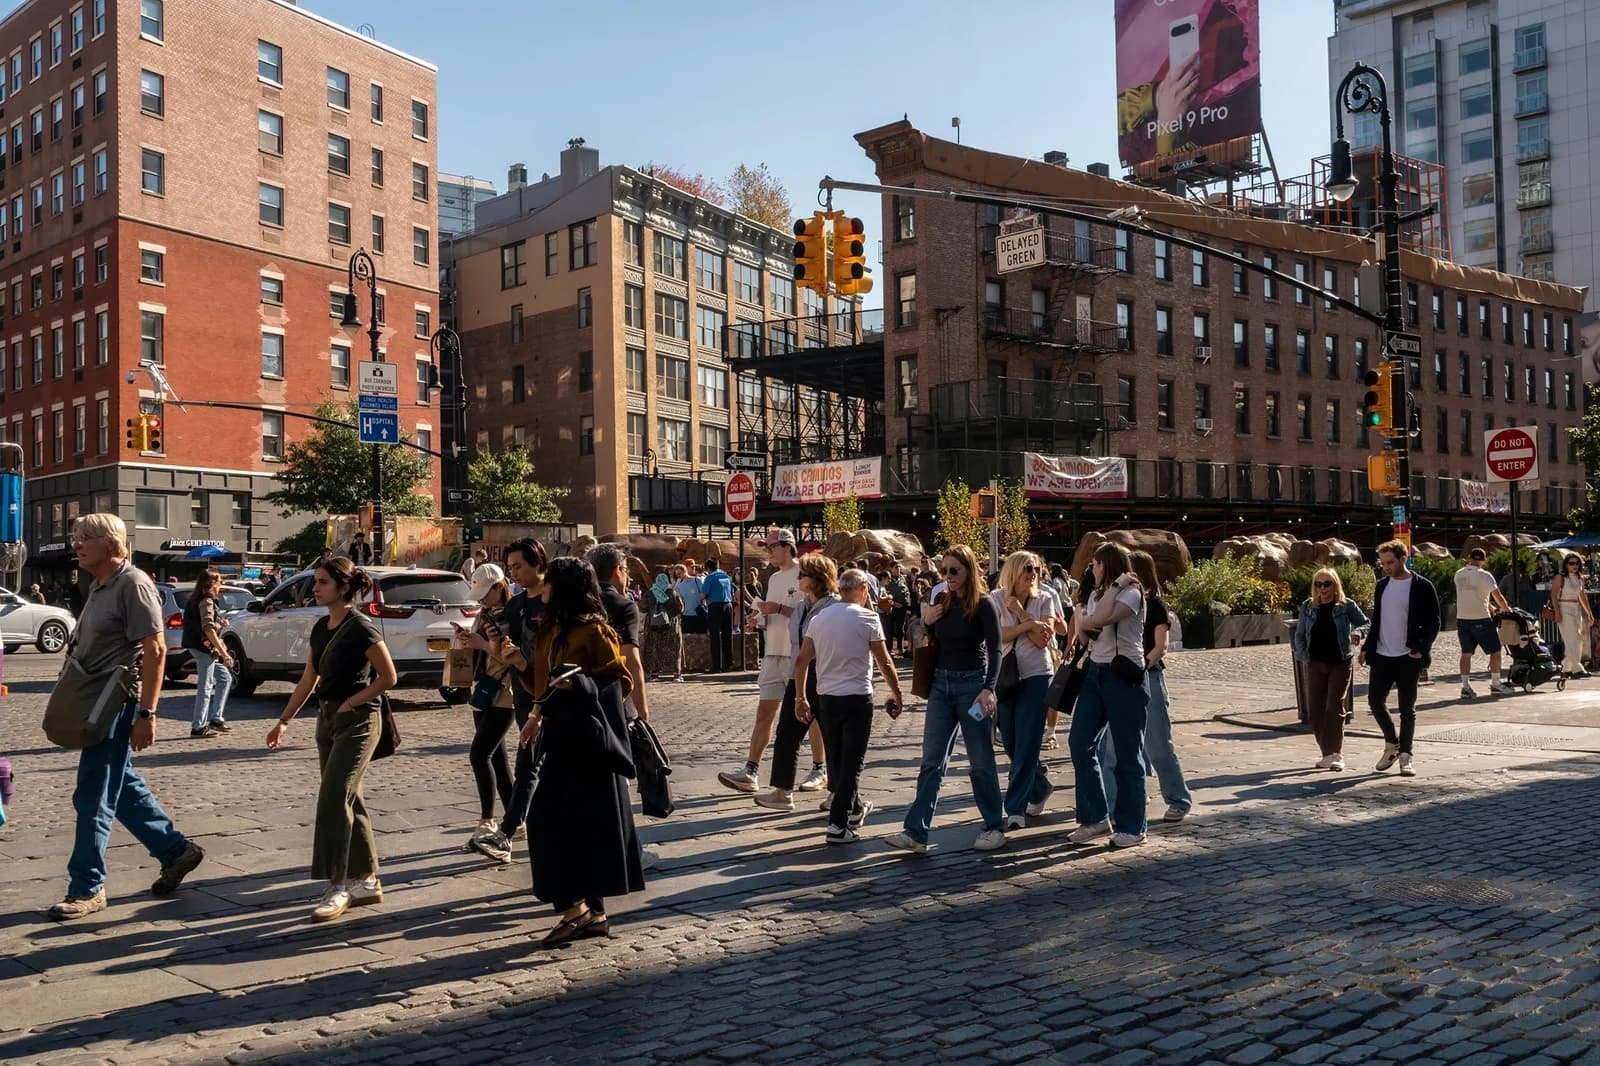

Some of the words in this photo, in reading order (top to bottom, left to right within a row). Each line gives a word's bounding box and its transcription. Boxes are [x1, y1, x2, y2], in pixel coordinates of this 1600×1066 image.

[1147, 118, 1183, 139] Pixel
[1186, 111, 1196, 127] 9
[1200, 106, 1228, 125] Pro
[1001, 233, 1040, 253] DELAYED
[1006, 249, 1036, 266] GREEN
[1494, 440, 1506, 448] DO
[1509, 438, 1526, 447] NOT
[730, 456, 743, 464] ONE
[749, 457, 762, 465] WAY
[1497, 461, 1526, 471] ENTER
[1054, 461, 1095, 475] AMINOS
[783, 470, 798, 483] DOS
[801, 466, 842, 482] CAMINOS
[730, 483, 739, 492] DO
[740, 481, 750, 490] NOT
[776, 485, 793, 497] WE
[794, 483, 814, 497] ARE
[817, 482, 846, 496] OPEN
[1048, 478, 1071, 488] ARE
[1075, 478, 1100, 489] OPEN
[732, 503, 749, 512] ENTER
